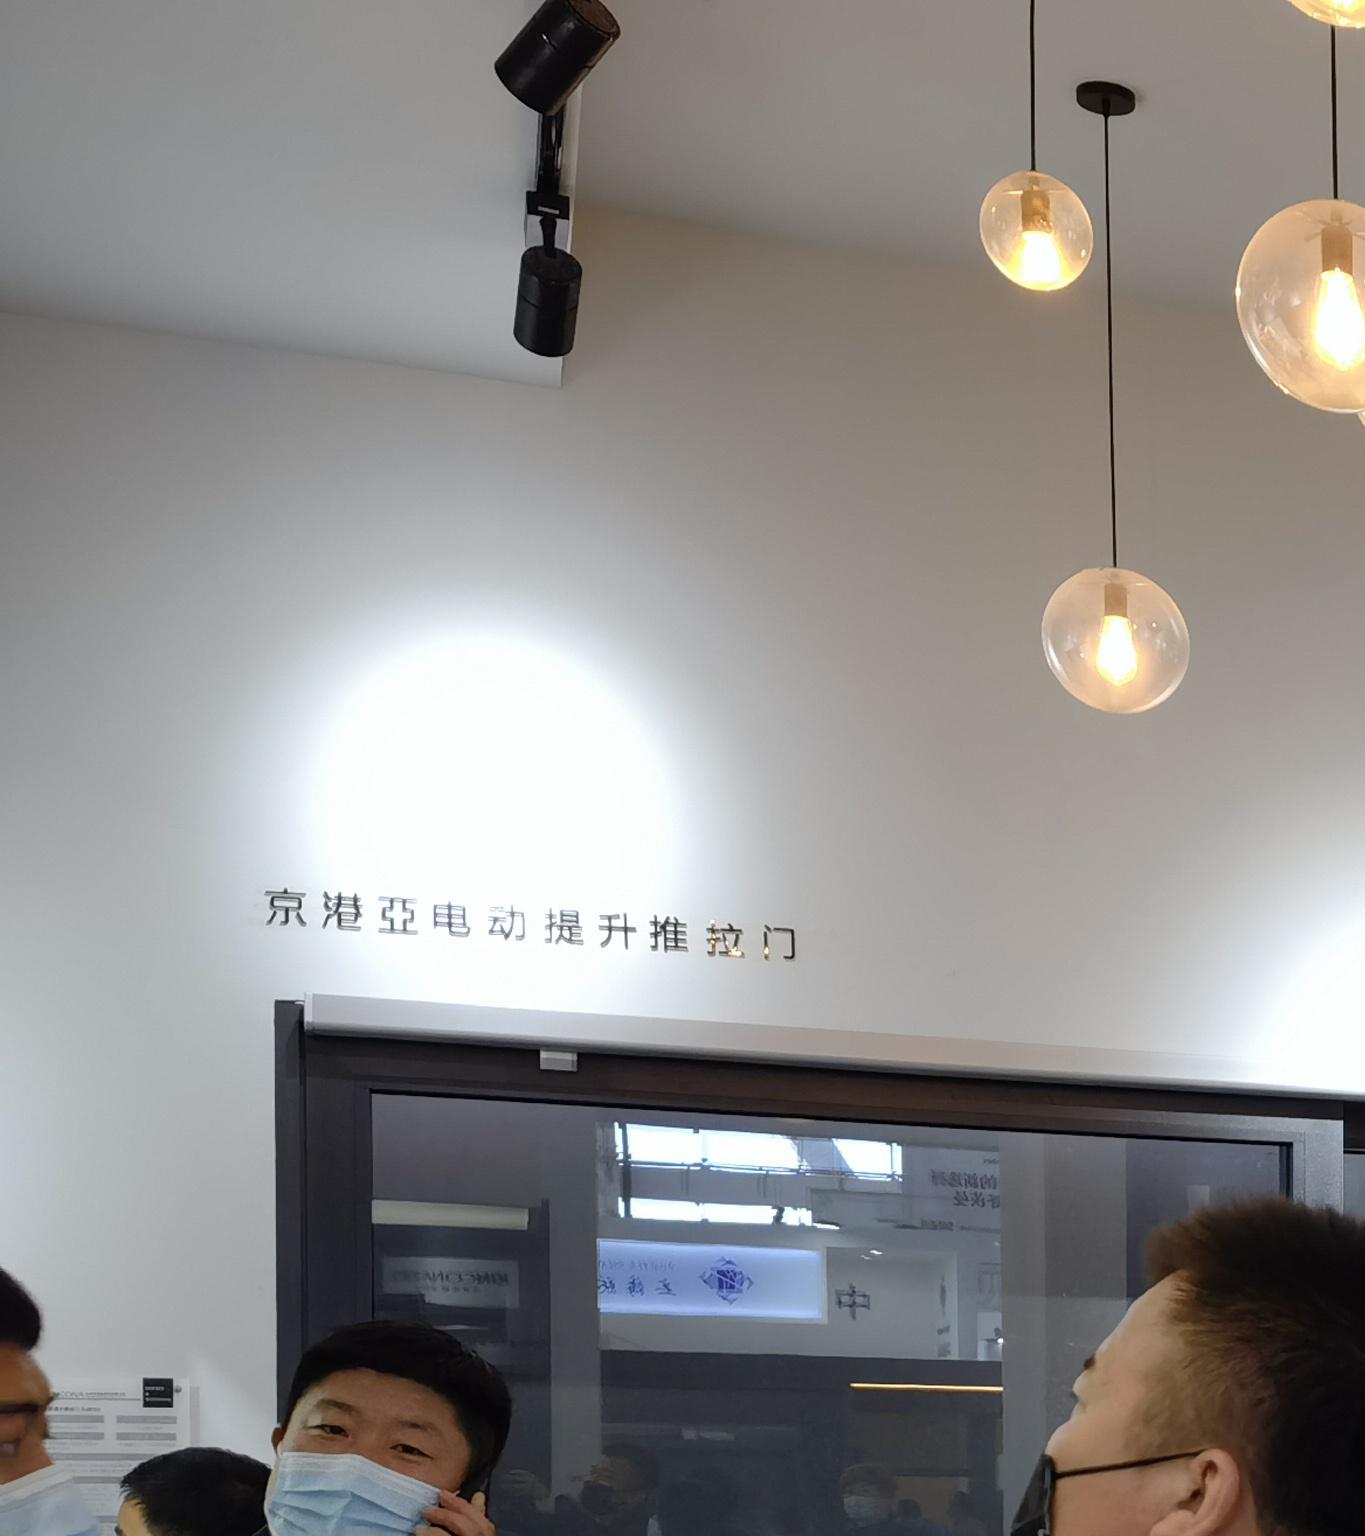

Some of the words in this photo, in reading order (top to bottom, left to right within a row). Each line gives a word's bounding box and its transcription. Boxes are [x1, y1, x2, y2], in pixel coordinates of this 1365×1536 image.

[264, 888, 797, 961] 京港亞电动提升推拉门
